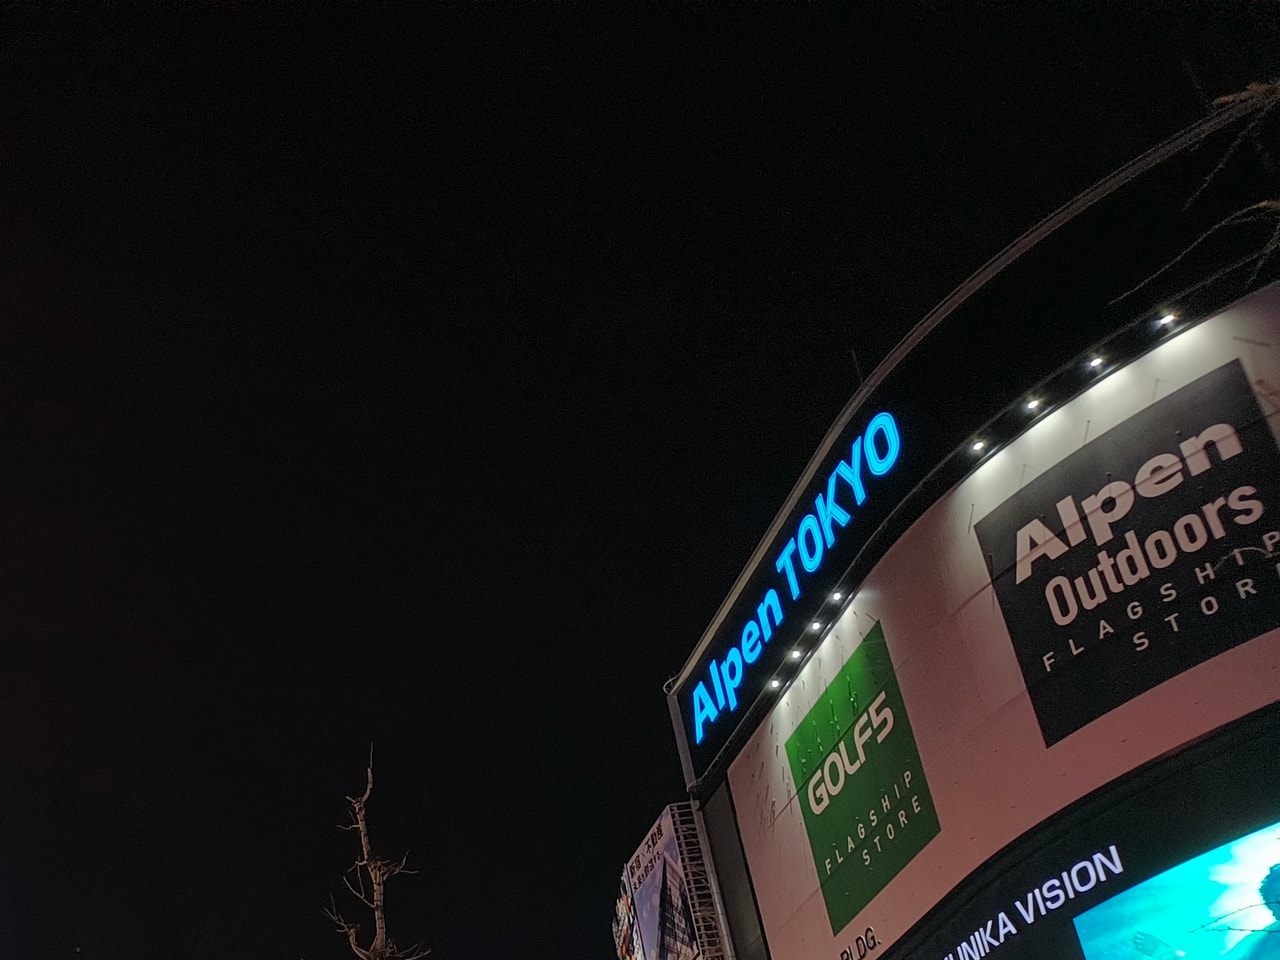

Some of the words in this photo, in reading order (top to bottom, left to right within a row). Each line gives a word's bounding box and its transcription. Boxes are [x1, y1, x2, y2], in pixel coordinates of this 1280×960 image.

[1016, 422, 1243, 584] Alpen
[1044, 485, 1264, 626] Outdoors
[691, 588, 785, 744] Alpen
[775, 412, 900, 601] TOKYO
[806, 691, 894, 815] GOLF5
[824, 771, 914, 875] FLAGSHIP
[861, 796, 922, 866] STORE
[1014, 844, 1124, 926] VISION
